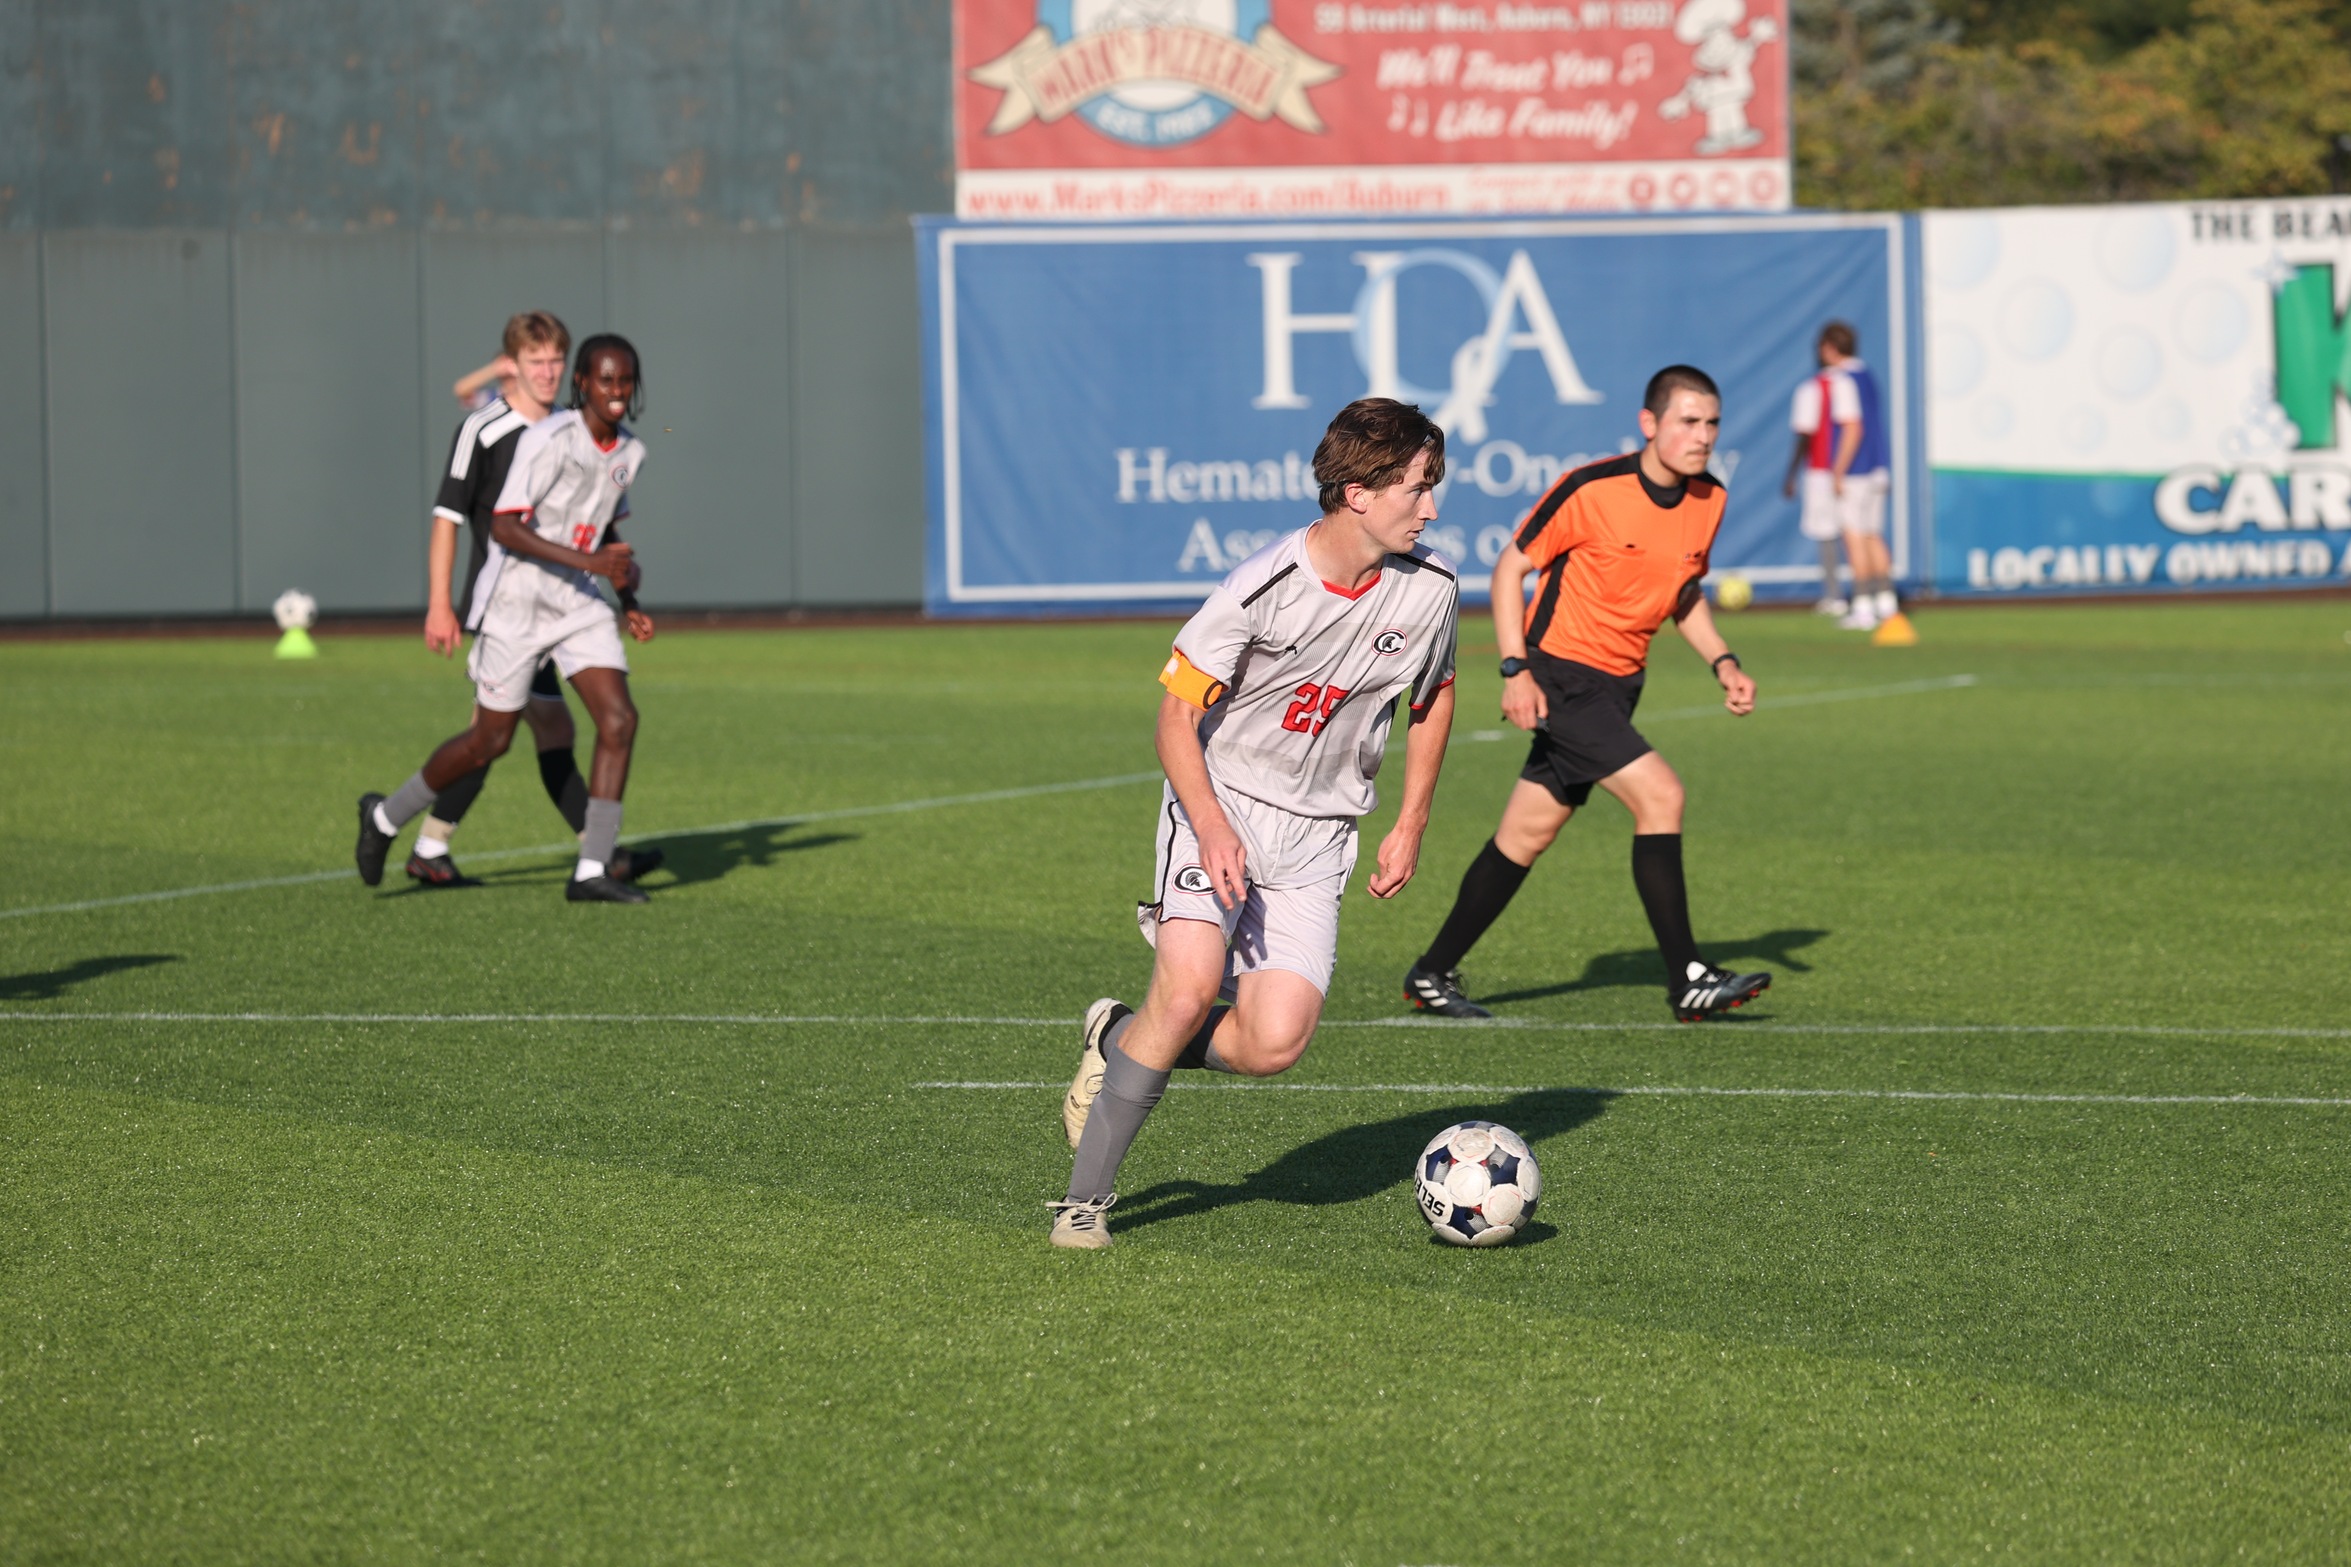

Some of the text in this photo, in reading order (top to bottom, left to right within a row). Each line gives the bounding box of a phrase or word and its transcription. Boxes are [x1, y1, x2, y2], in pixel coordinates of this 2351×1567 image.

[1375, 42, 1614, 92] We'll Treat You
[1434, 96, 1640, 150] Like Family!
[2192, 207, 2351, 242] THE BEA
[2153, 463, 2351, 534] CAR
[1968, 543, 2160, 590] LOCALLY
[2165, 539, 2332, 587] OWNED
[1281, 683, 1351, 737] 25
